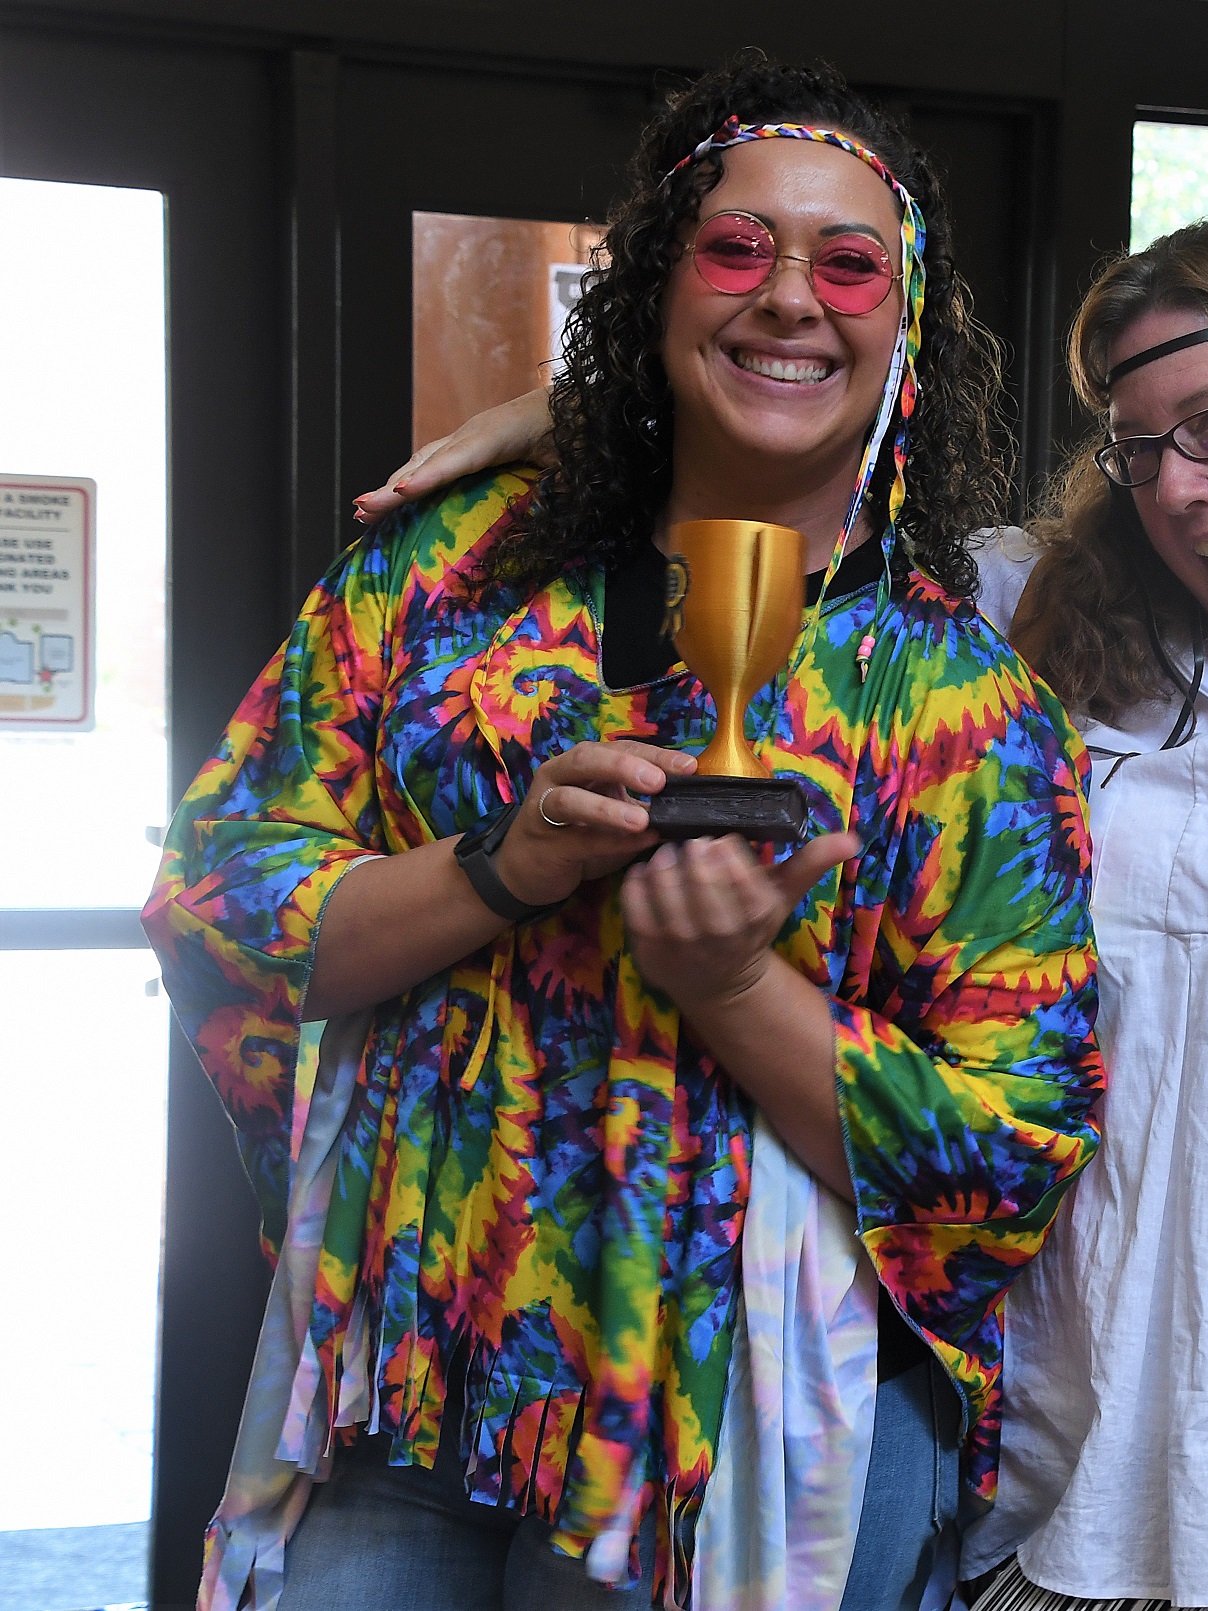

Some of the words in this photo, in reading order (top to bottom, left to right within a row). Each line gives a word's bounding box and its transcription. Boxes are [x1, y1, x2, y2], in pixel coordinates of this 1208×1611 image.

[4, 494, 13, 503] A
[19, 494, 70, 506] SMOKE
[24, 540, 52, 550] USE
[22, 569, 70, 581] AREAS
[22, 584, 53, 595] YOU
